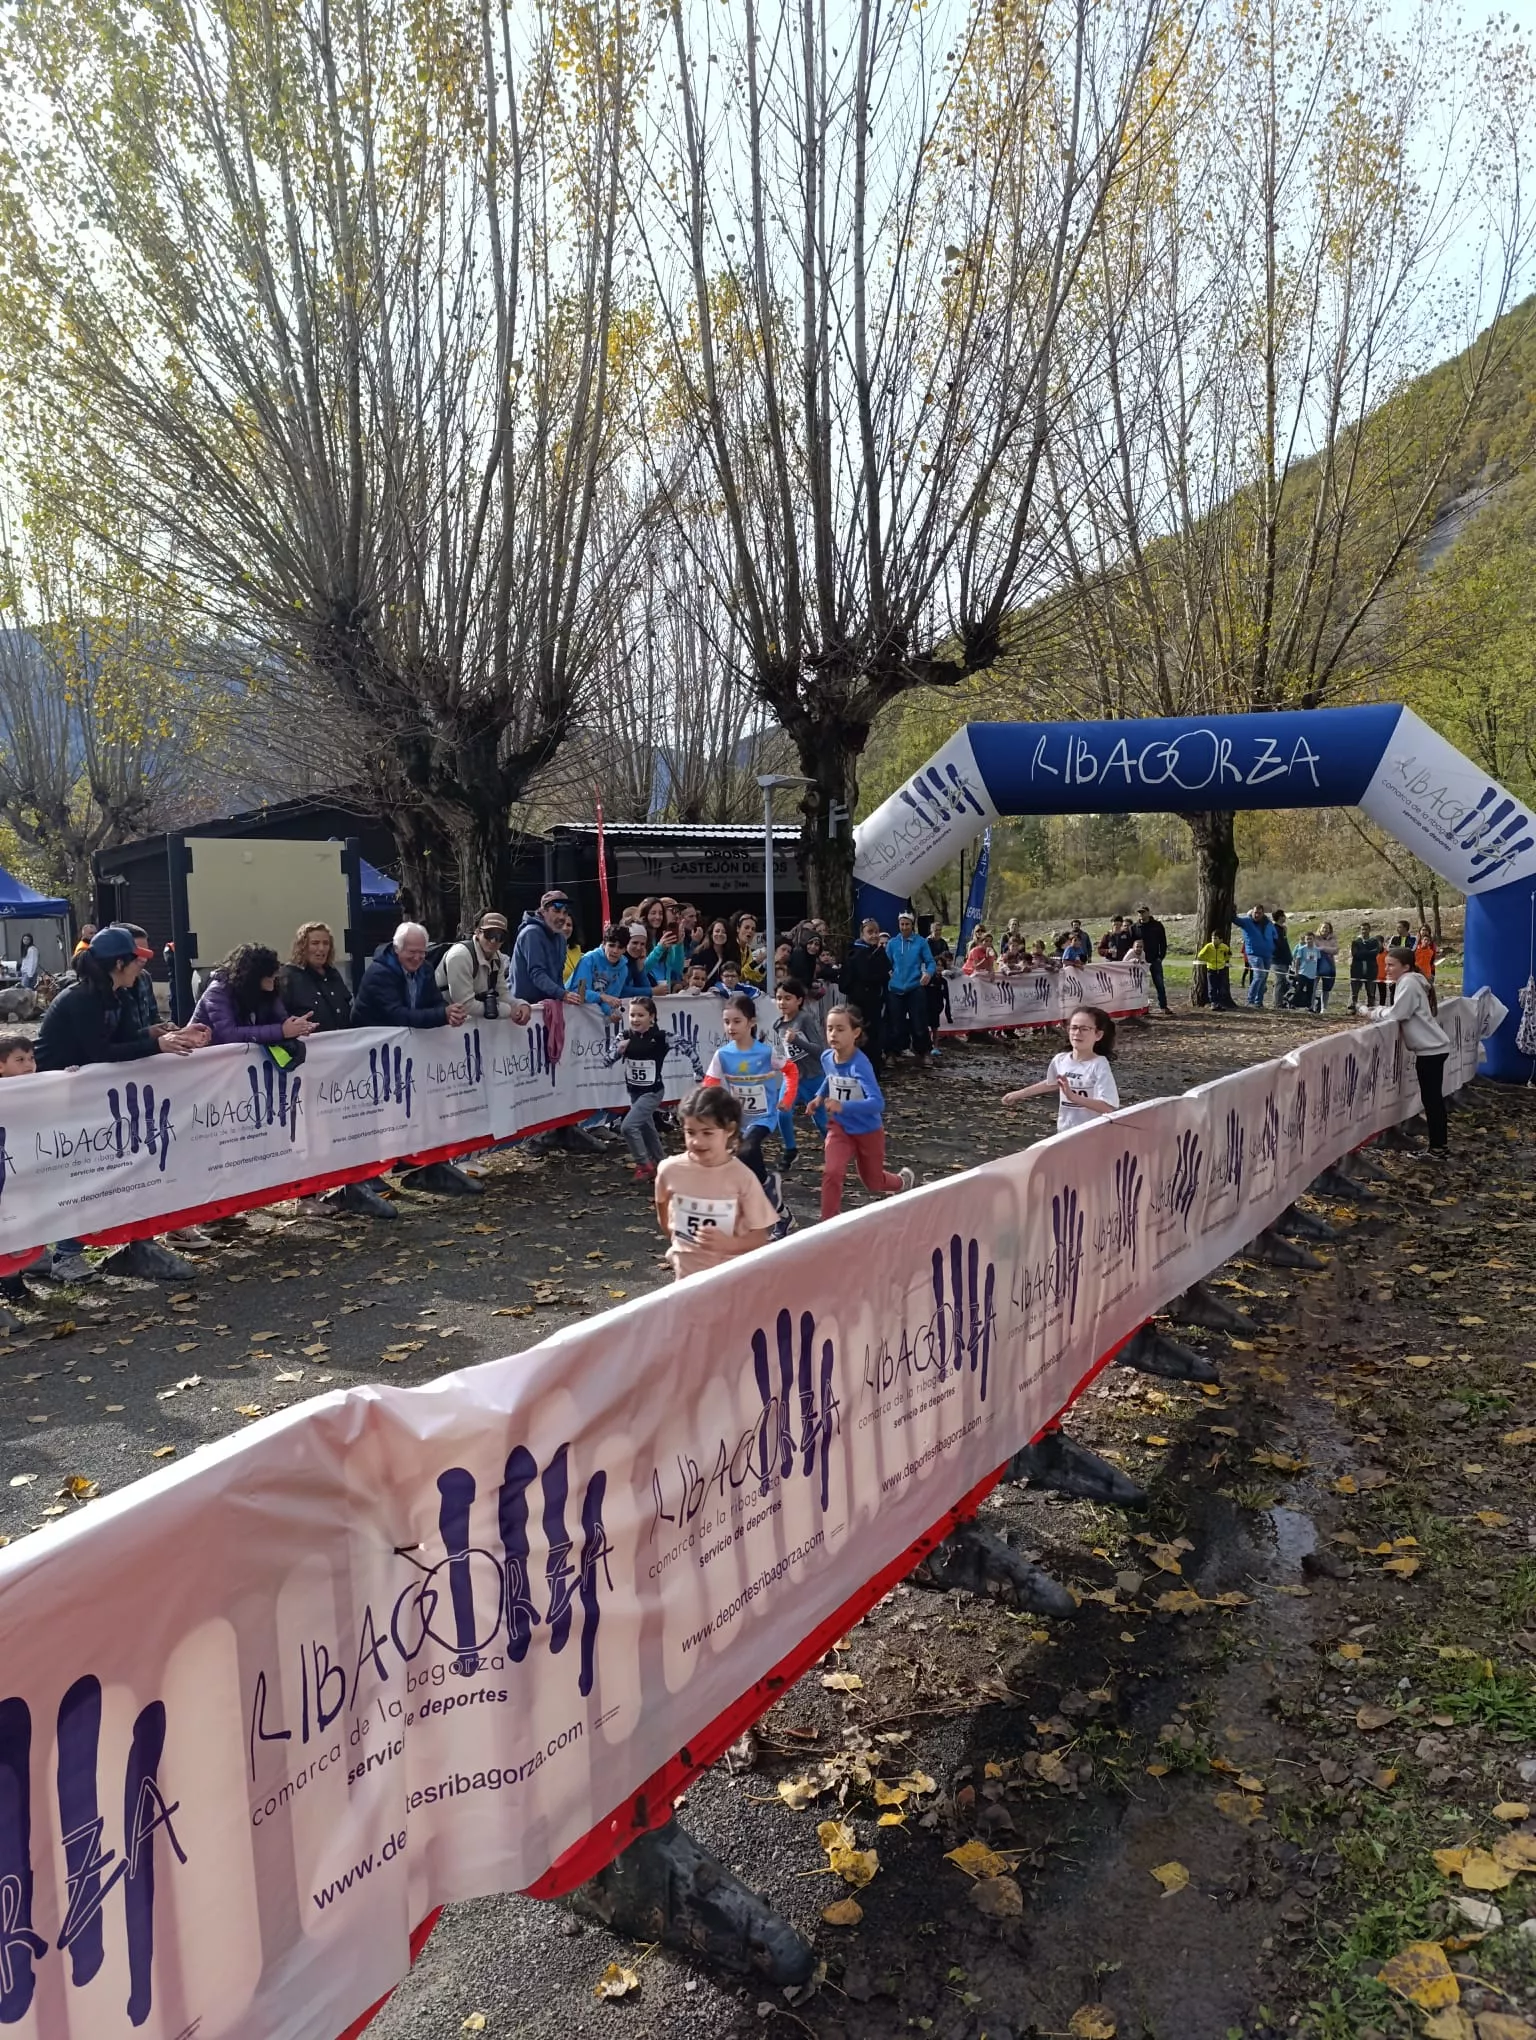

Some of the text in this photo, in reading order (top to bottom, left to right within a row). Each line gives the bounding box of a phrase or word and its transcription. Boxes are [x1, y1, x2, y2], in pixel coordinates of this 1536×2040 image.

[1031, 729, 1320, 789] RIBAGORZA
[670, 860, 739, 874] CASTEJÓN
[742, 862, 759, 874] DE
[632, 1069, 647, 1081] 55
[836, 1087, 851, 1101] 77
[34, 1116, 177, 1161] RIBAGORZA
[191, 1091, 303, 1129] RIBAGORZA
[860, 1293, 998, 1402] RIBAGORZA
[858, 1400, 892, 1430] comarca
[893, 1390, 904, 1407] de
[893, 1385, 956, 1429] servicio de deportes
[650, 1377, 841, 1545] RIBAGORZA
[648, 1533, 696, 1579] comarca
[699, 1519, 713, 1539] de
[716, 1507, 727, 1527] la
[699, 1499, 783, 1568] servicio de deportes
[681, 1529, 825, 1653] www.deportesribagorza.com
[251, 1522, 615, 1783] RIBAGORZA
[252, 1742, 342, 1827] comarca
[350, 1717, 371, 1747] de
[378, 1697, 404, 1722] la
[346, 1734, 406, 1787] servici
[419, 1688, 509, 1719] deportes
